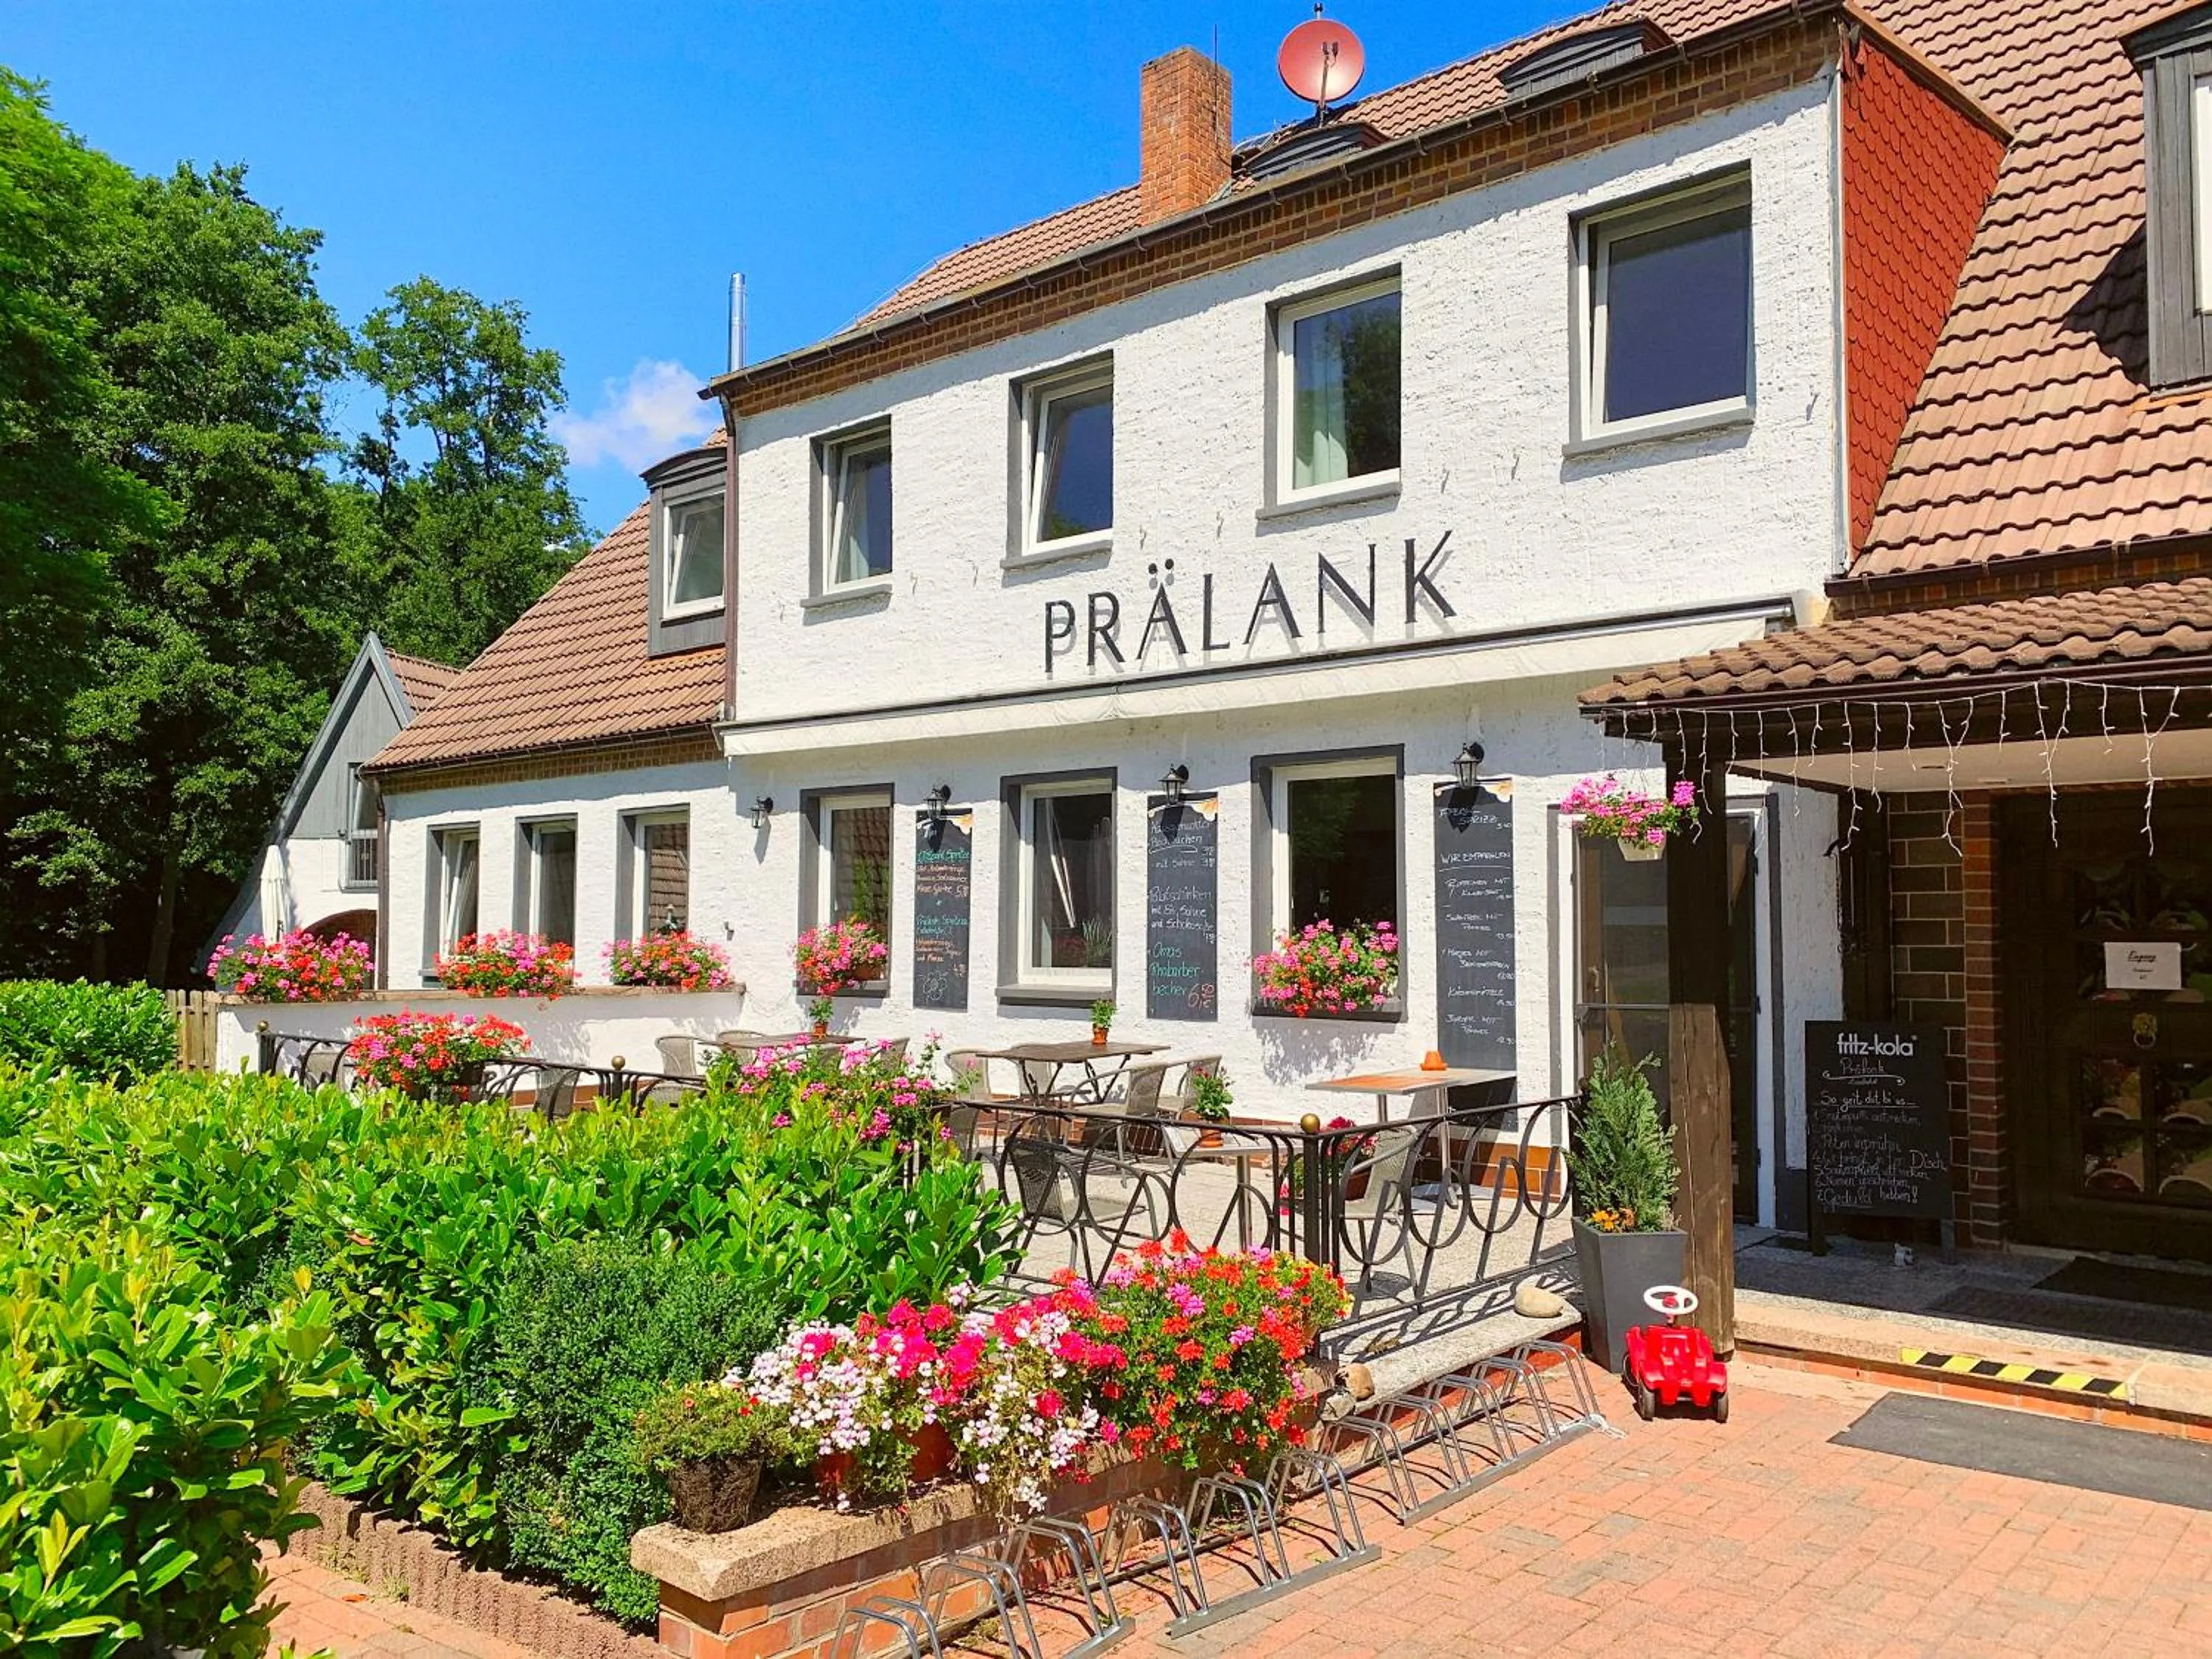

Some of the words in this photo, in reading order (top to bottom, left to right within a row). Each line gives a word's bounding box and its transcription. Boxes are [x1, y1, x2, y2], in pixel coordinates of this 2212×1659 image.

[1045, 530, 1457, 672] PRÄLANK
[1837, 1033, 1913, 1057] fritz-kola
[1820, 1090, 1837, 1106] So
